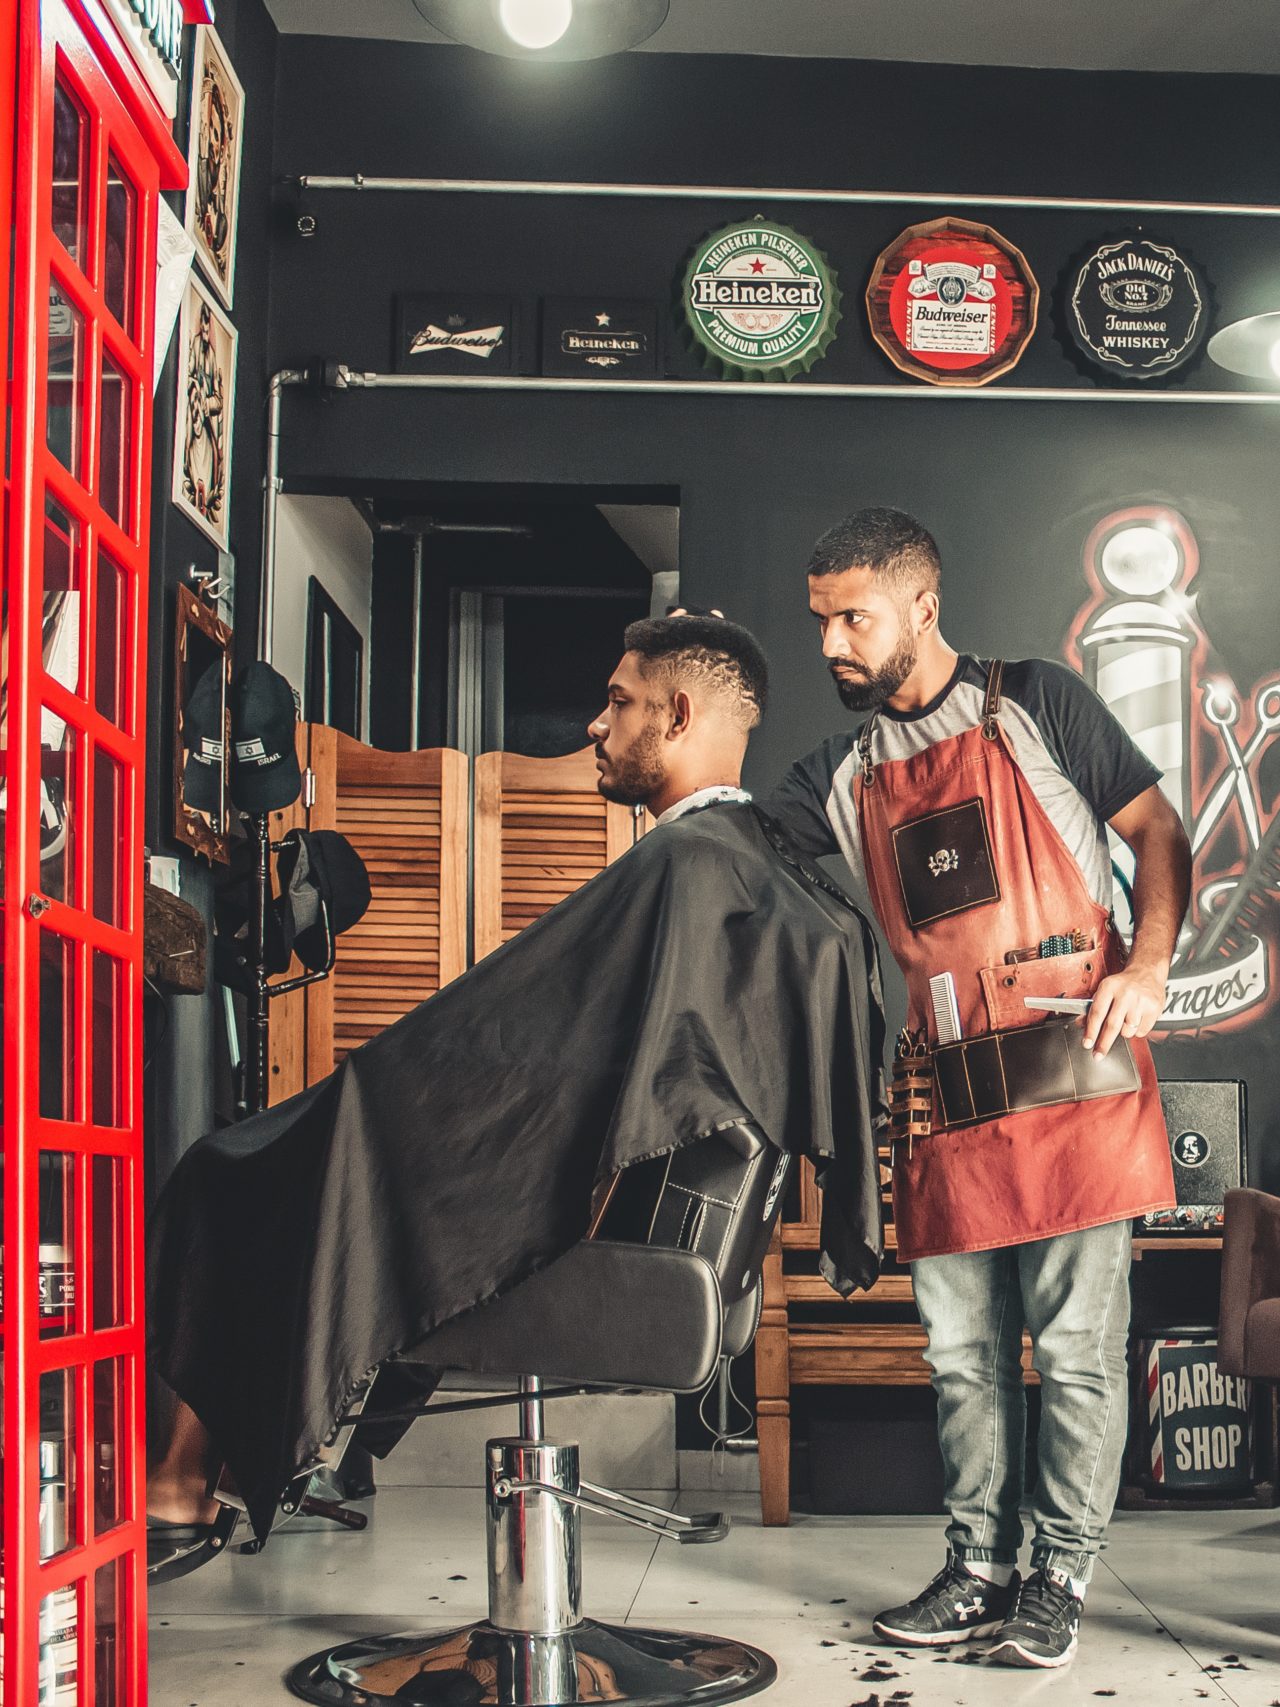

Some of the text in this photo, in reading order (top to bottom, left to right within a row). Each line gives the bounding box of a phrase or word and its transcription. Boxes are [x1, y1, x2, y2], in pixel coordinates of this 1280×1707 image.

[706, 233, 808, 271] HEINEKEN PILSENER
[1098, 258, 1127, 280] JACK
[699, 281, 817, 304] Heineken
[1126, 284, 1146, 293] Old
[915, 306, 988, 323] Budweiser
[1105, 314, 1167, 332] Tennessee
[411, 329, 504, 348] Budweiser
[569, 336, 640, 350] Heineken
[708, 319, 806, 355] PREMIUM QUALITY
[1102, 336, 1169, 349] WHISKEY
[258, 752, 282, 767] ISRAEL
[1162, 969, 1255, 1019] ingos
[1175, 1424, 1242, 1472] SHOP
